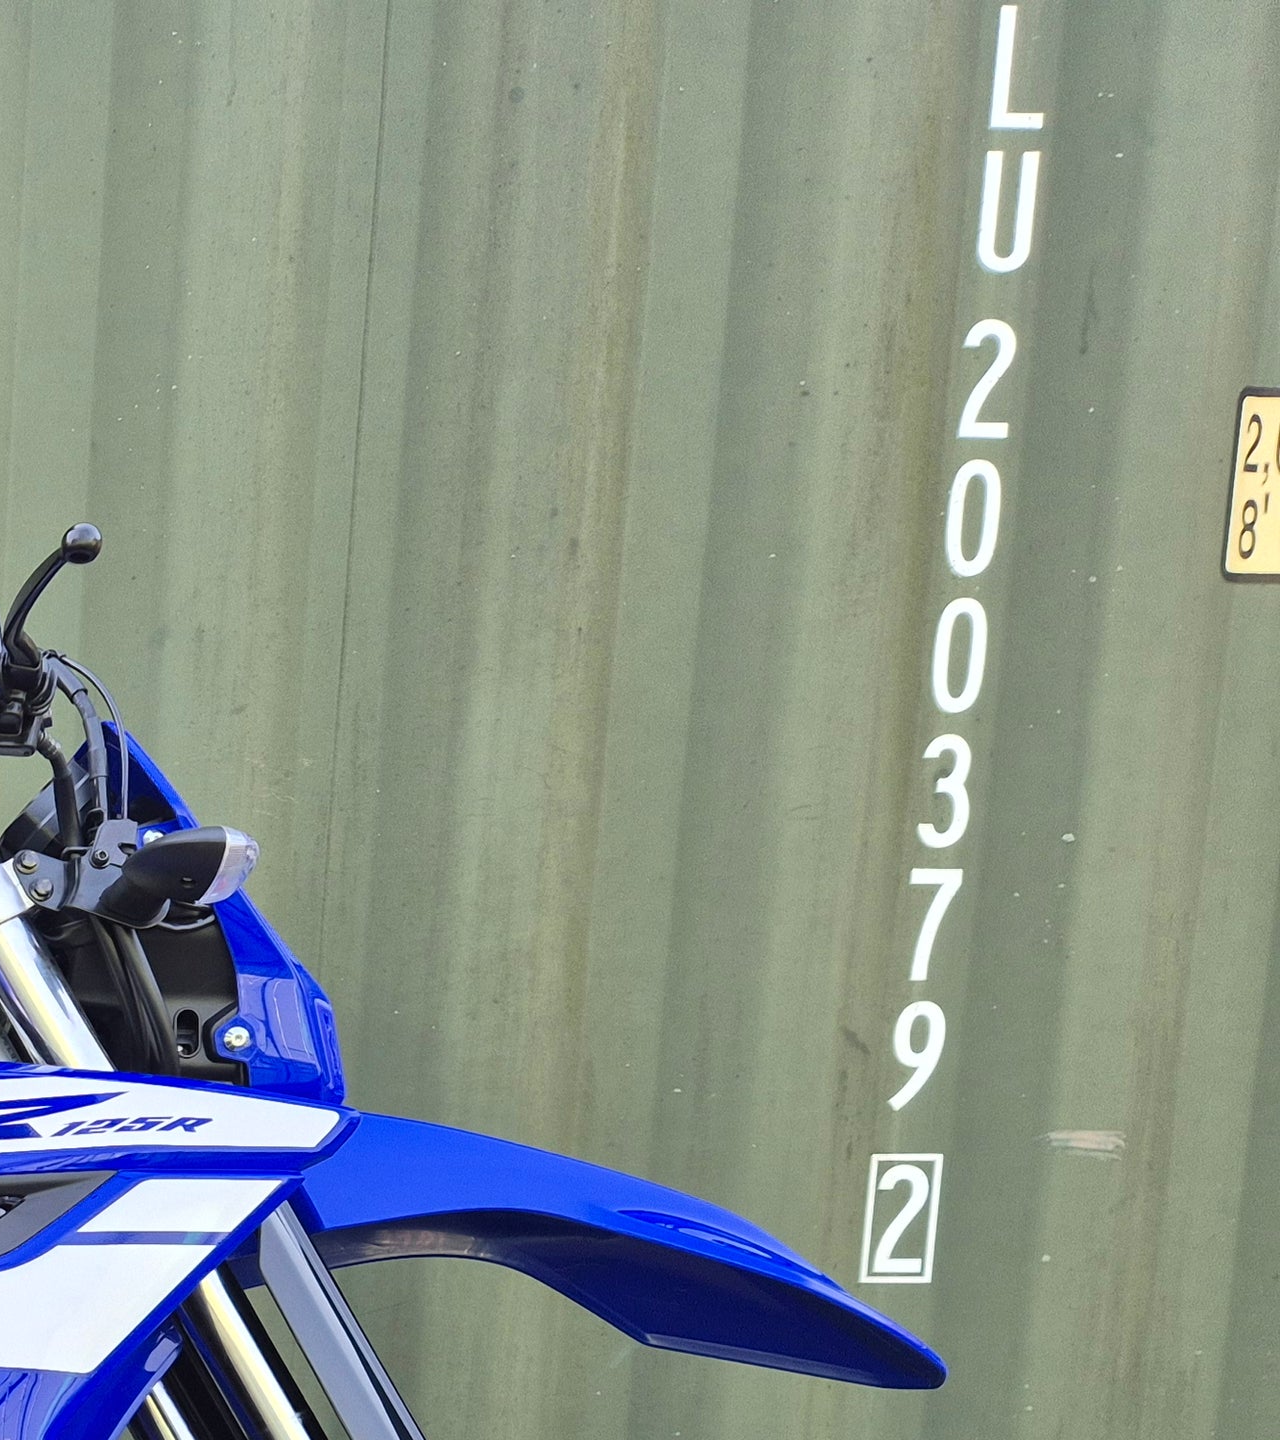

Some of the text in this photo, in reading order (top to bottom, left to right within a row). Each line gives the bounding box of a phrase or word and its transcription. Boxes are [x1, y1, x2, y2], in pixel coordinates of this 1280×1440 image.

[1242, 413, 1280, 486] 2,
[889, 319, 1016, 1110] 200379
[49, 1116, 215, 1138] 125R
[874, 1163, 932, 1275] 2
